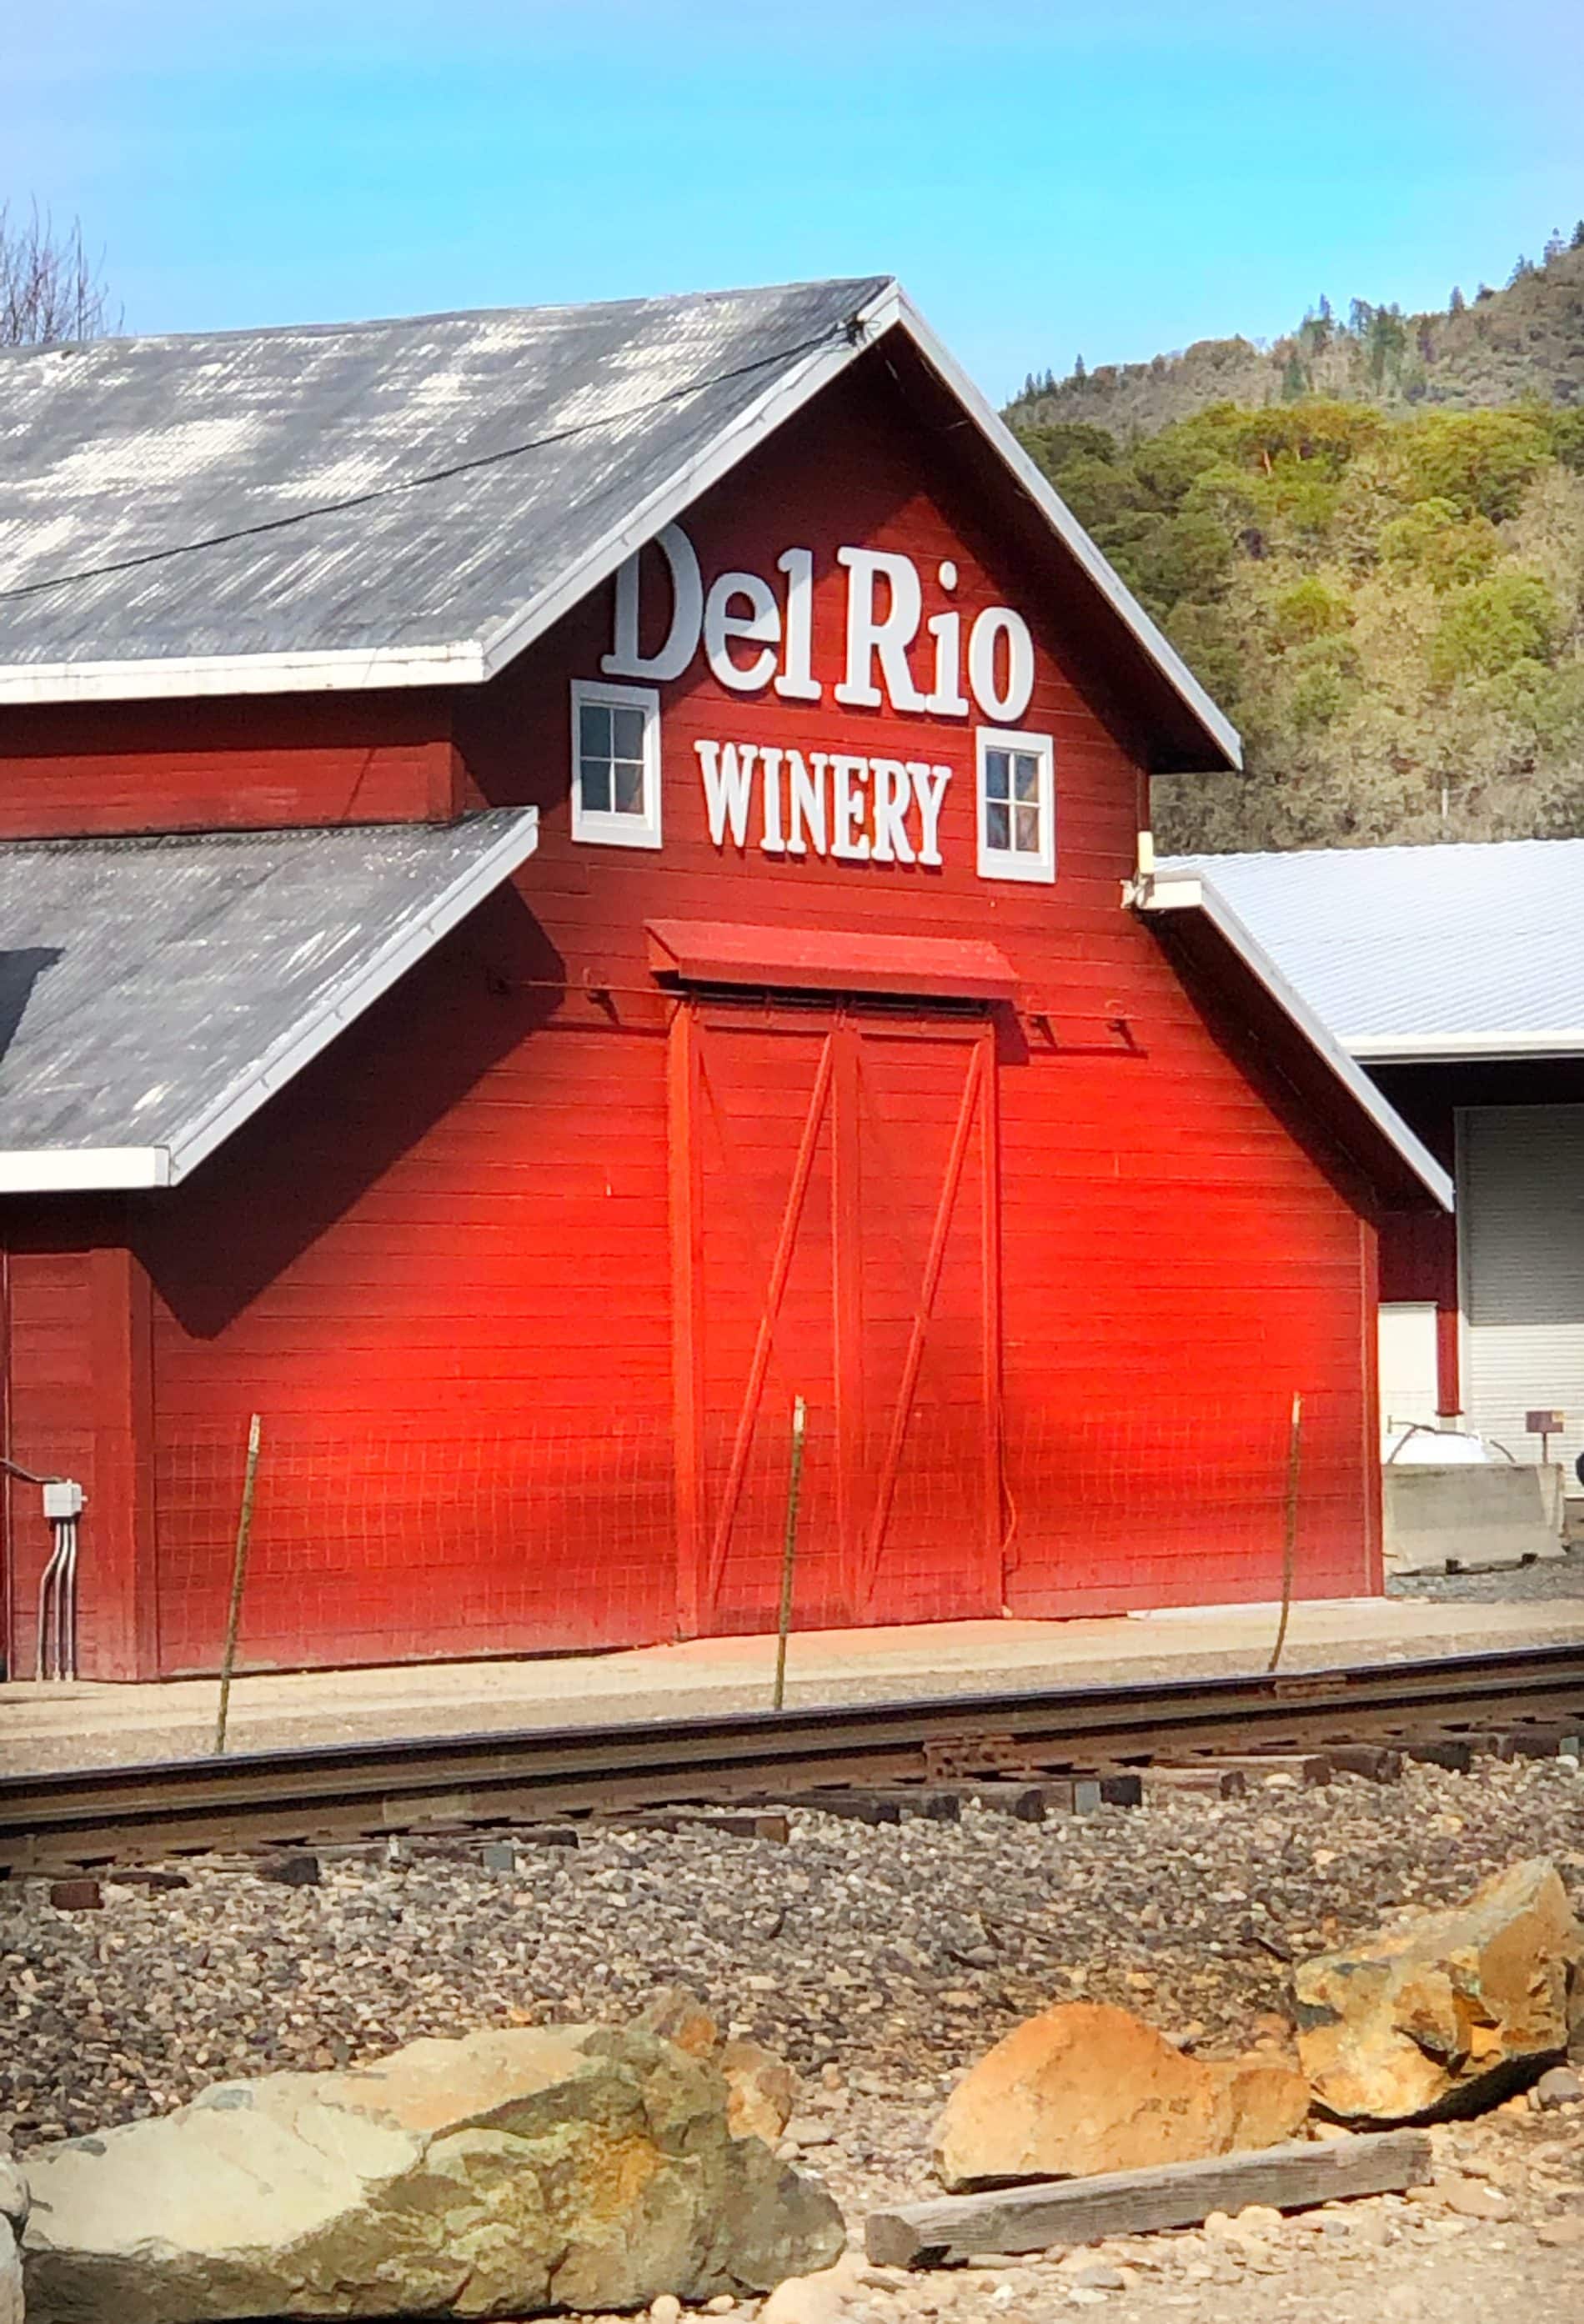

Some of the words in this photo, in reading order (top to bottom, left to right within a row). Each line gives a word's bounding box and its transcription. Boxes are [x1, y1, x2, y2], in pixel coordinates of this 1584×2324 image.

[601, 523, 822, 699] Del
[835, 546, 1035, 722] Rio
[694, 739, 951, 866] WINERY
